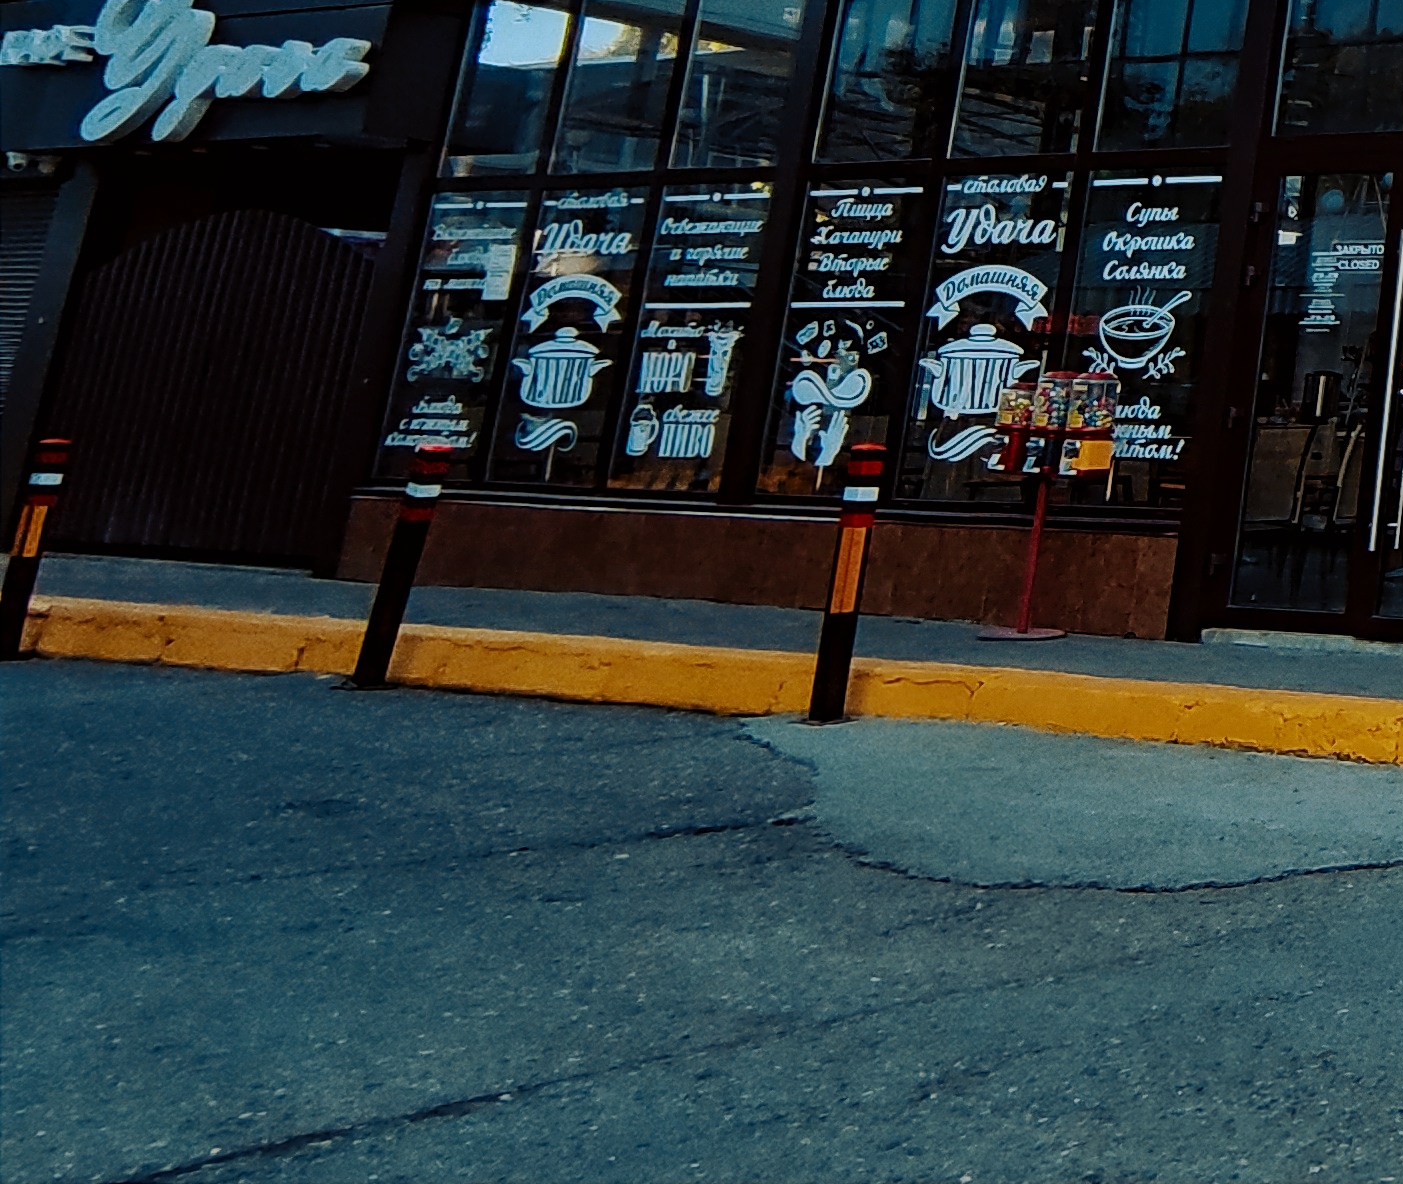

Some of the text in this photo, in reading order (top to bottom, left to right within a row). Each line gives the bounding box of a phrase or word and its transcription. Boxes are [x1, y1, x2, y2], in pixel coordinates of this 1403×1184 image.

[963, 174, 1048, 194] столовая
[831, 198, 894, 221] Пицца
[1126, 202, 1180, 227] Супы
[941, 204, 1057, 254] Удача
[1102, 231, 1195, 258] Окрошка
[1102, 260, 1187, 280] Солянка
[1338, 259, 1380, 270] CLOSED
[943, 271, 1039, 301] Домашняя
[658, 423, 716, 458] ПИВО
